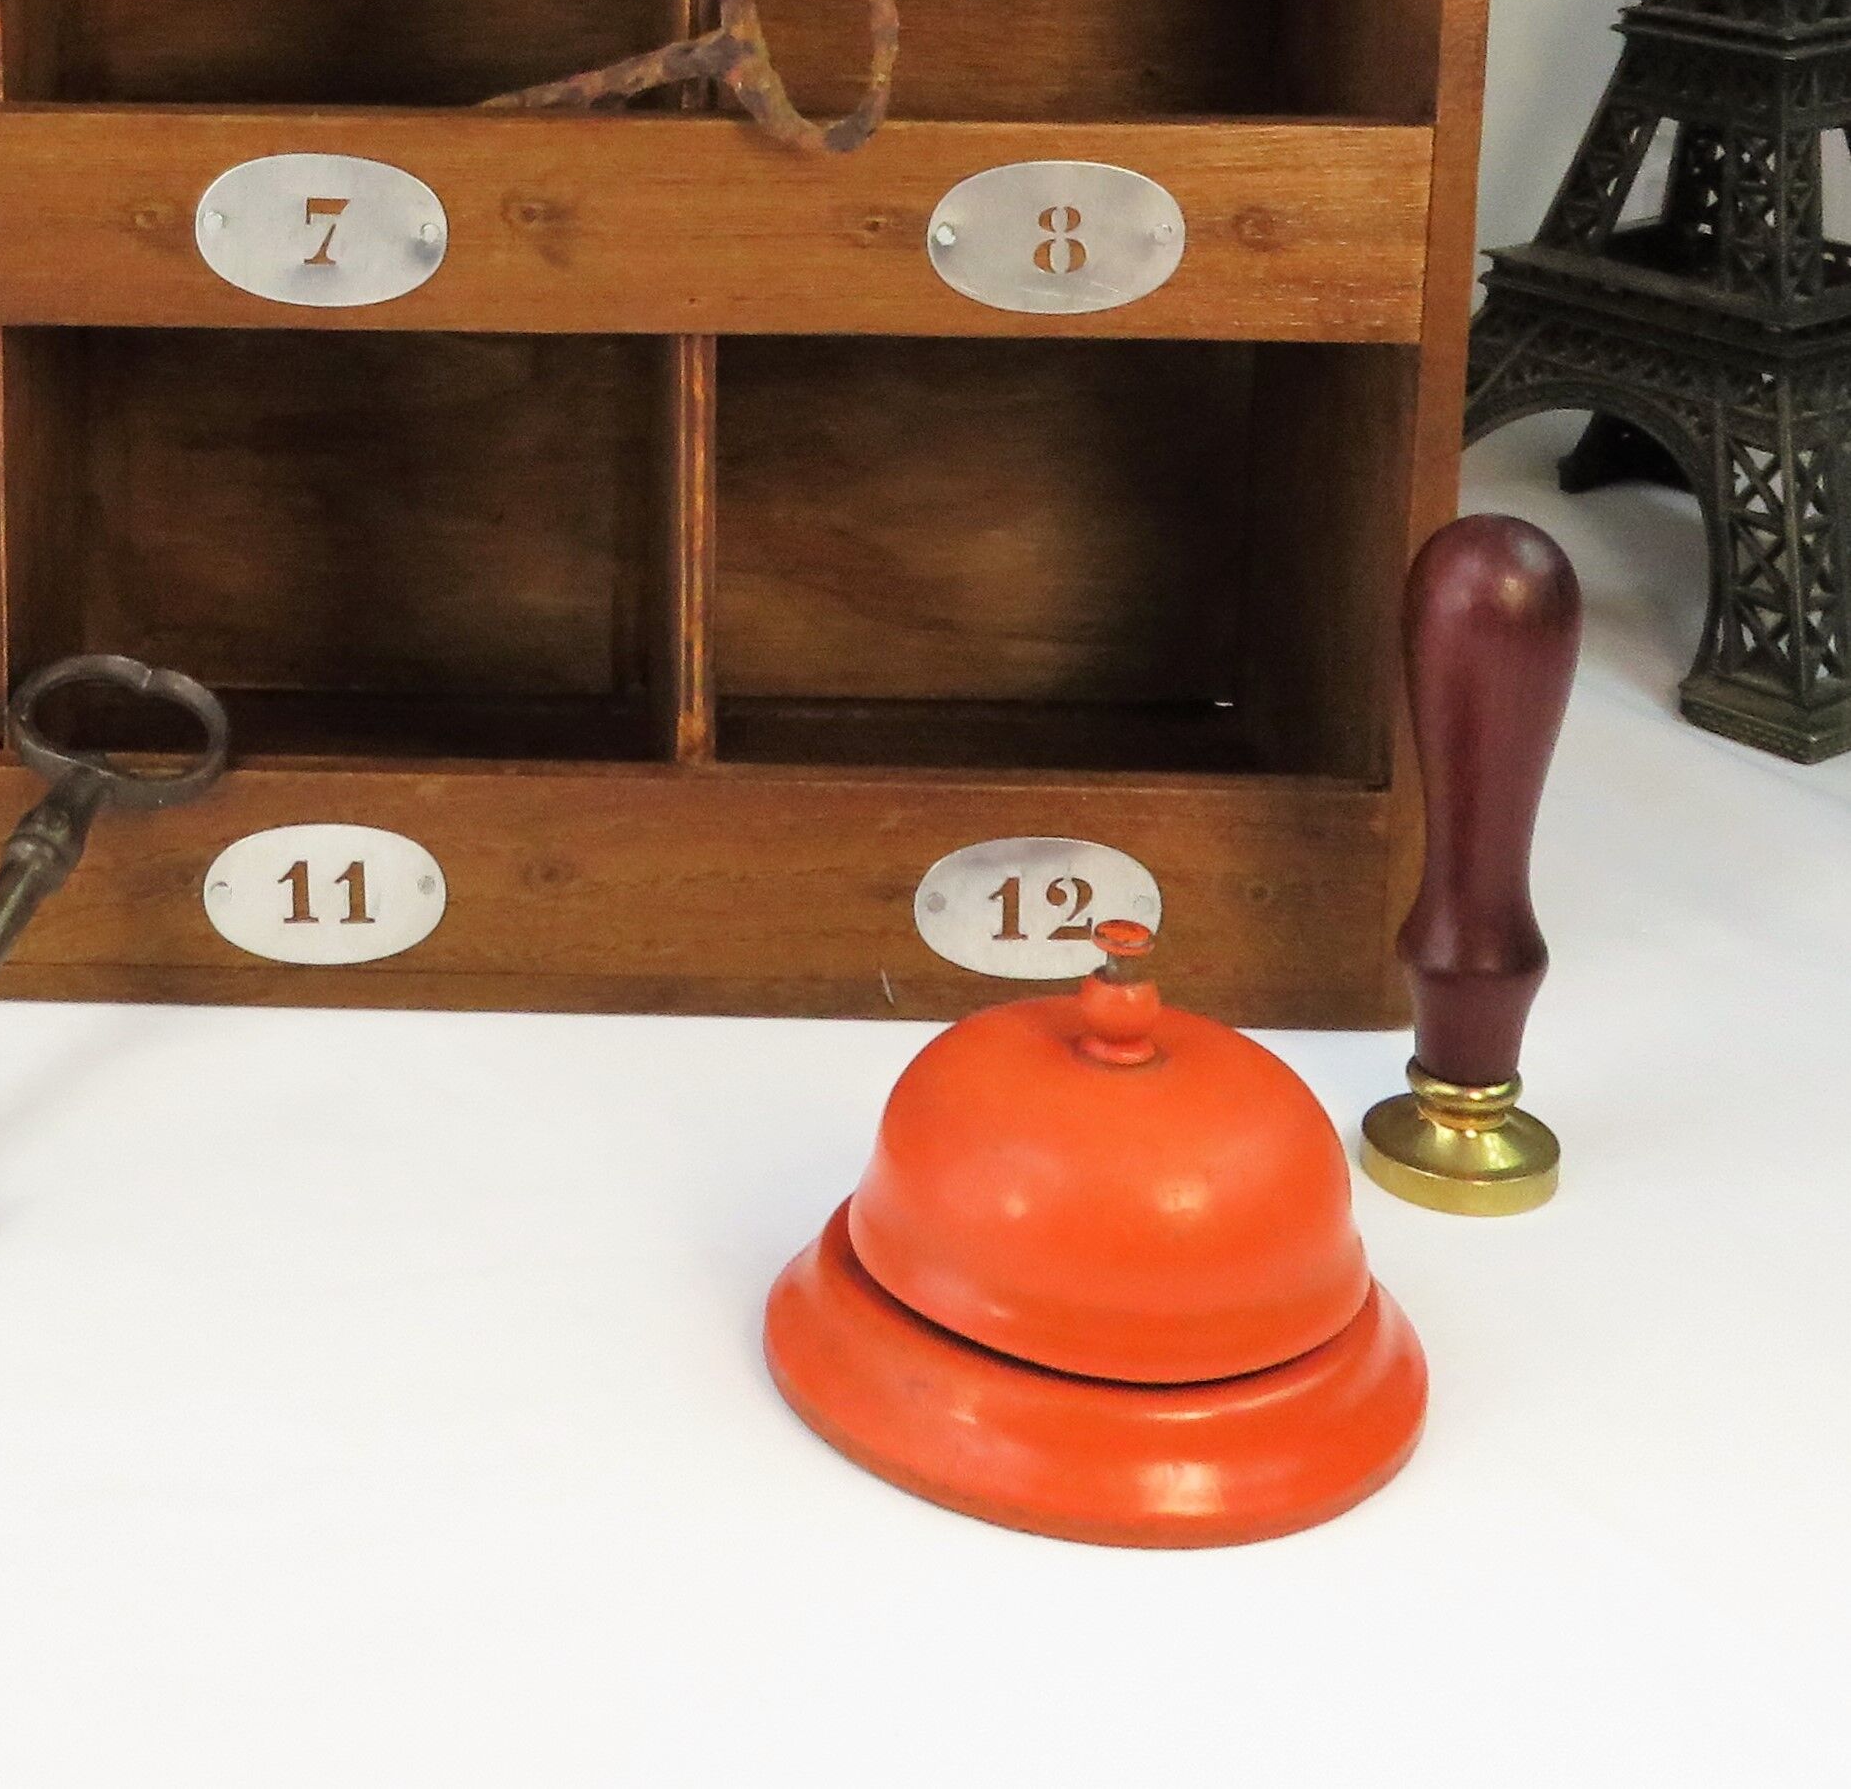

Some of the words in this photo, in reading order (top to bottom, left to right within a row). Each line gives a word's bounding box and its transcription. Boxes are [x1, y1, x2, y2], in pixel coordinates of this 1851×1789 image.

[304, 196, 349, 266] 7
[1034, 206, 1087, 275] 8
[279, 861, 374, 924] 11
[989, 876, 1093, 941] 12
